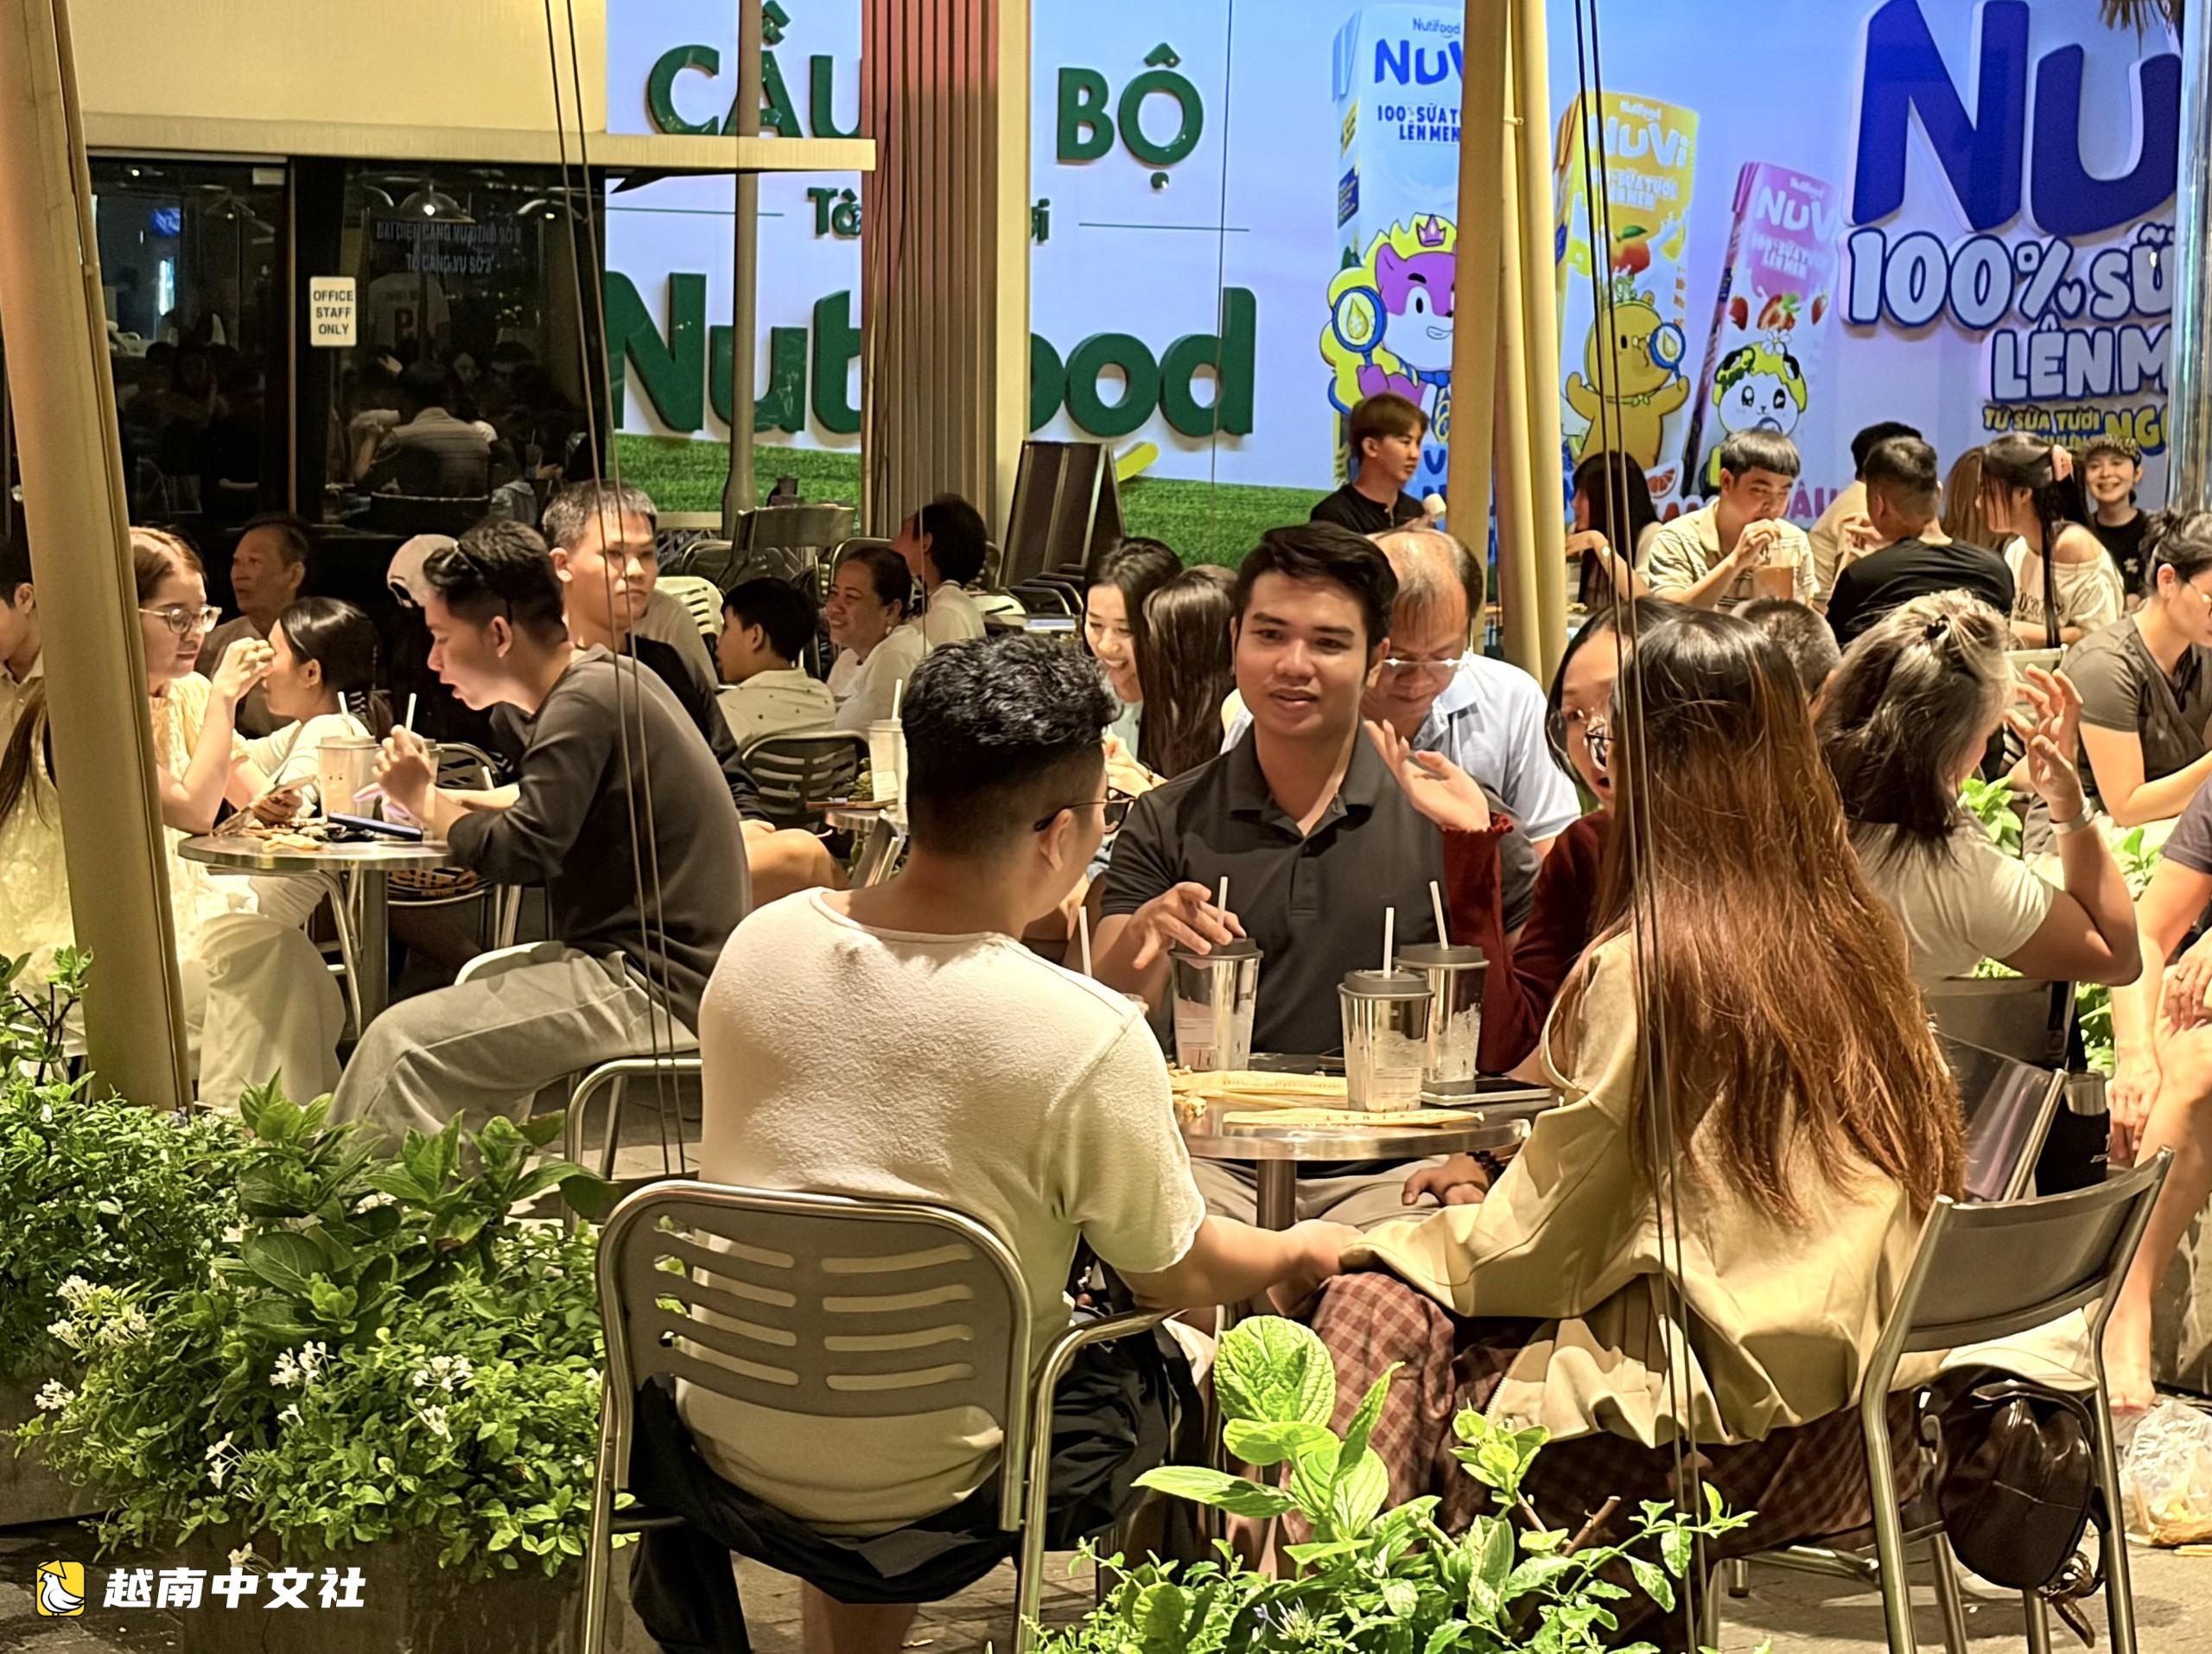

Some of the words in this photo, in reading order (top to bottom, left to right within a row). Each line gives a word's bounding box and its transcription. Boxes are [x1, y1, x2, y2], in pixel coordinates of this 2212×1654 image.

[1413, 17, 1460, 35] Nutifood
[1374, 38, 1462, 85] Nu
[1057, 42, 1204, 189] BỘ
[1852, 0, 2182, 237] Nu
[1755, 186, 1838, 243] NuV
[313, 289, 353, 302] OFFICE
[1847, 226, 2074, 330] 100%
[2088, 222, 2176, 322] SỮ
[316, 307, 352, 318] STAFF
[318, 323, 349, 335] ONLY
[606, 270, 1256, 438] Nutod
[1991, 313, 2116, 403] LÊN
[2118, 324, 2172, 396] M
